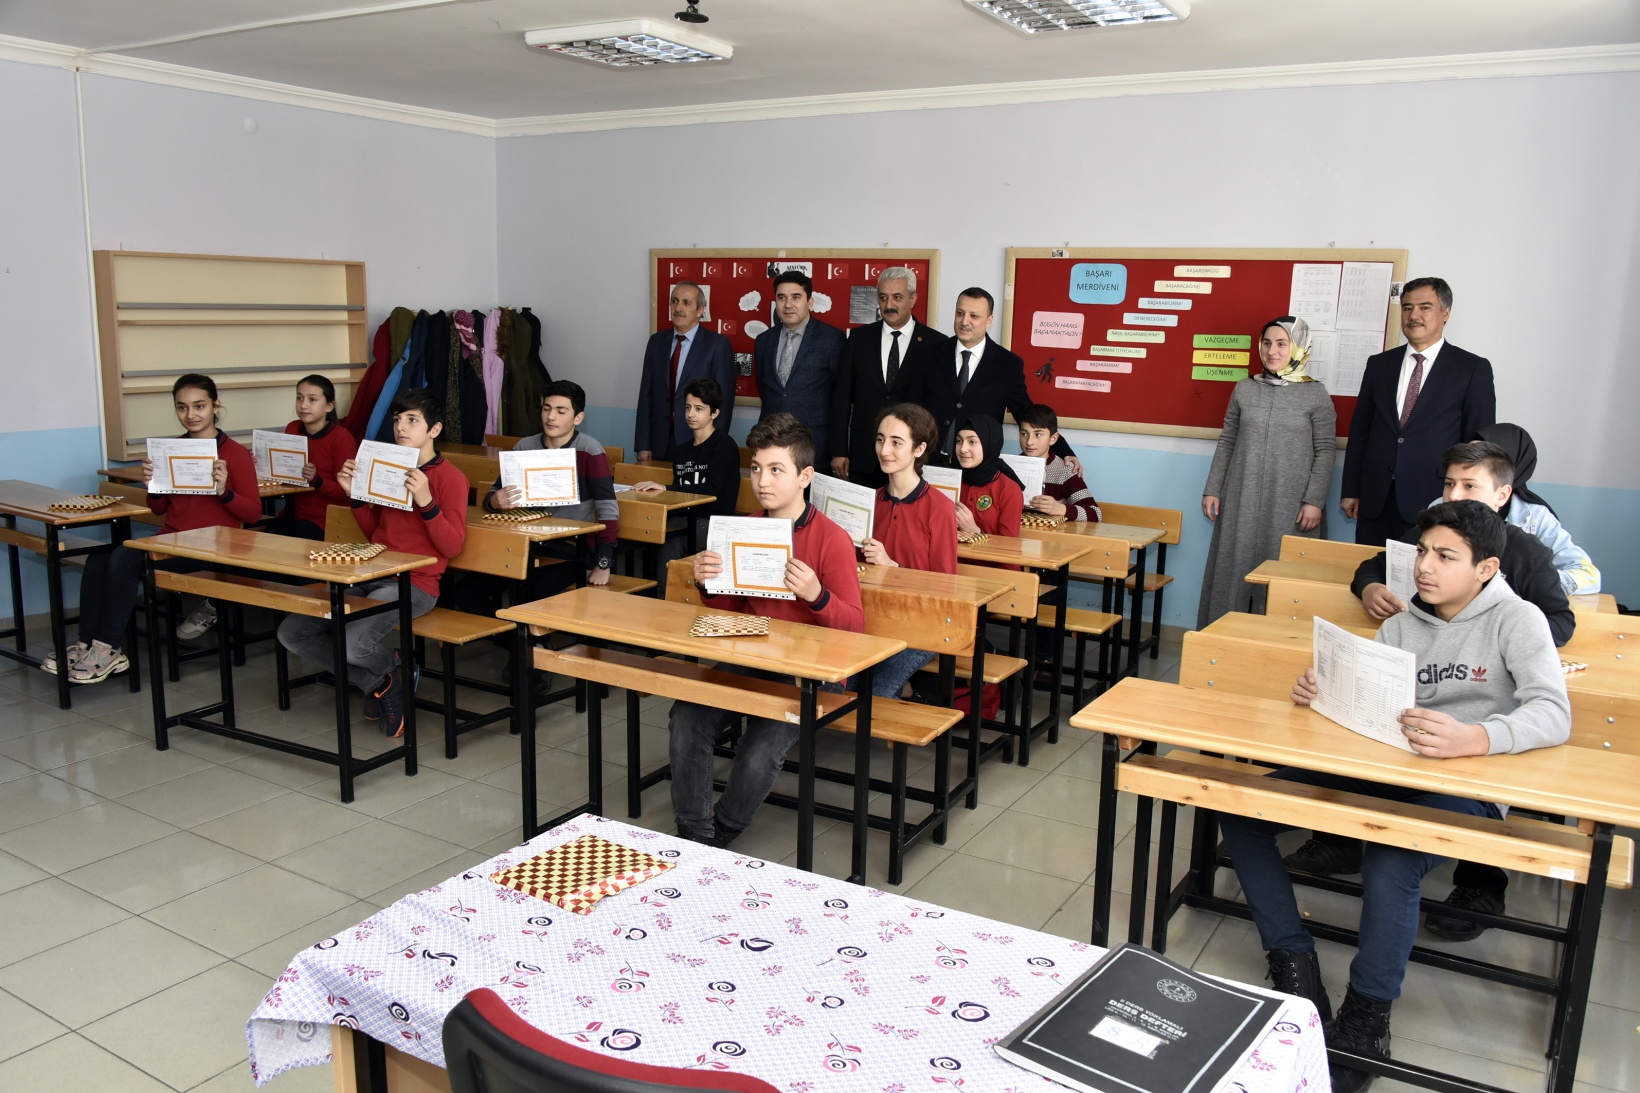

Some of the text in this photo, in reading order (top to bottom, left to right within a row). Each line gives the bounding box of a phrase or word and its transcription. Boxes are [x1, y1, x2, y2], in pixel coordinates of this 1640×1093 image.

[1085, 269, 1112, 279] BAŞARI
[1076, 283, 1119, 291] MERDİVENİ
[1206, 368, 1234, 376] ÜŞENME
[1108, 999, 1139, 1015] DERS
[1139, 1013, 1188, 1038] DEFTERİ
[1125, 1001, 1144, 1011] DERS
[1145, 1009, 1184, 1031] YOKLAMALI
